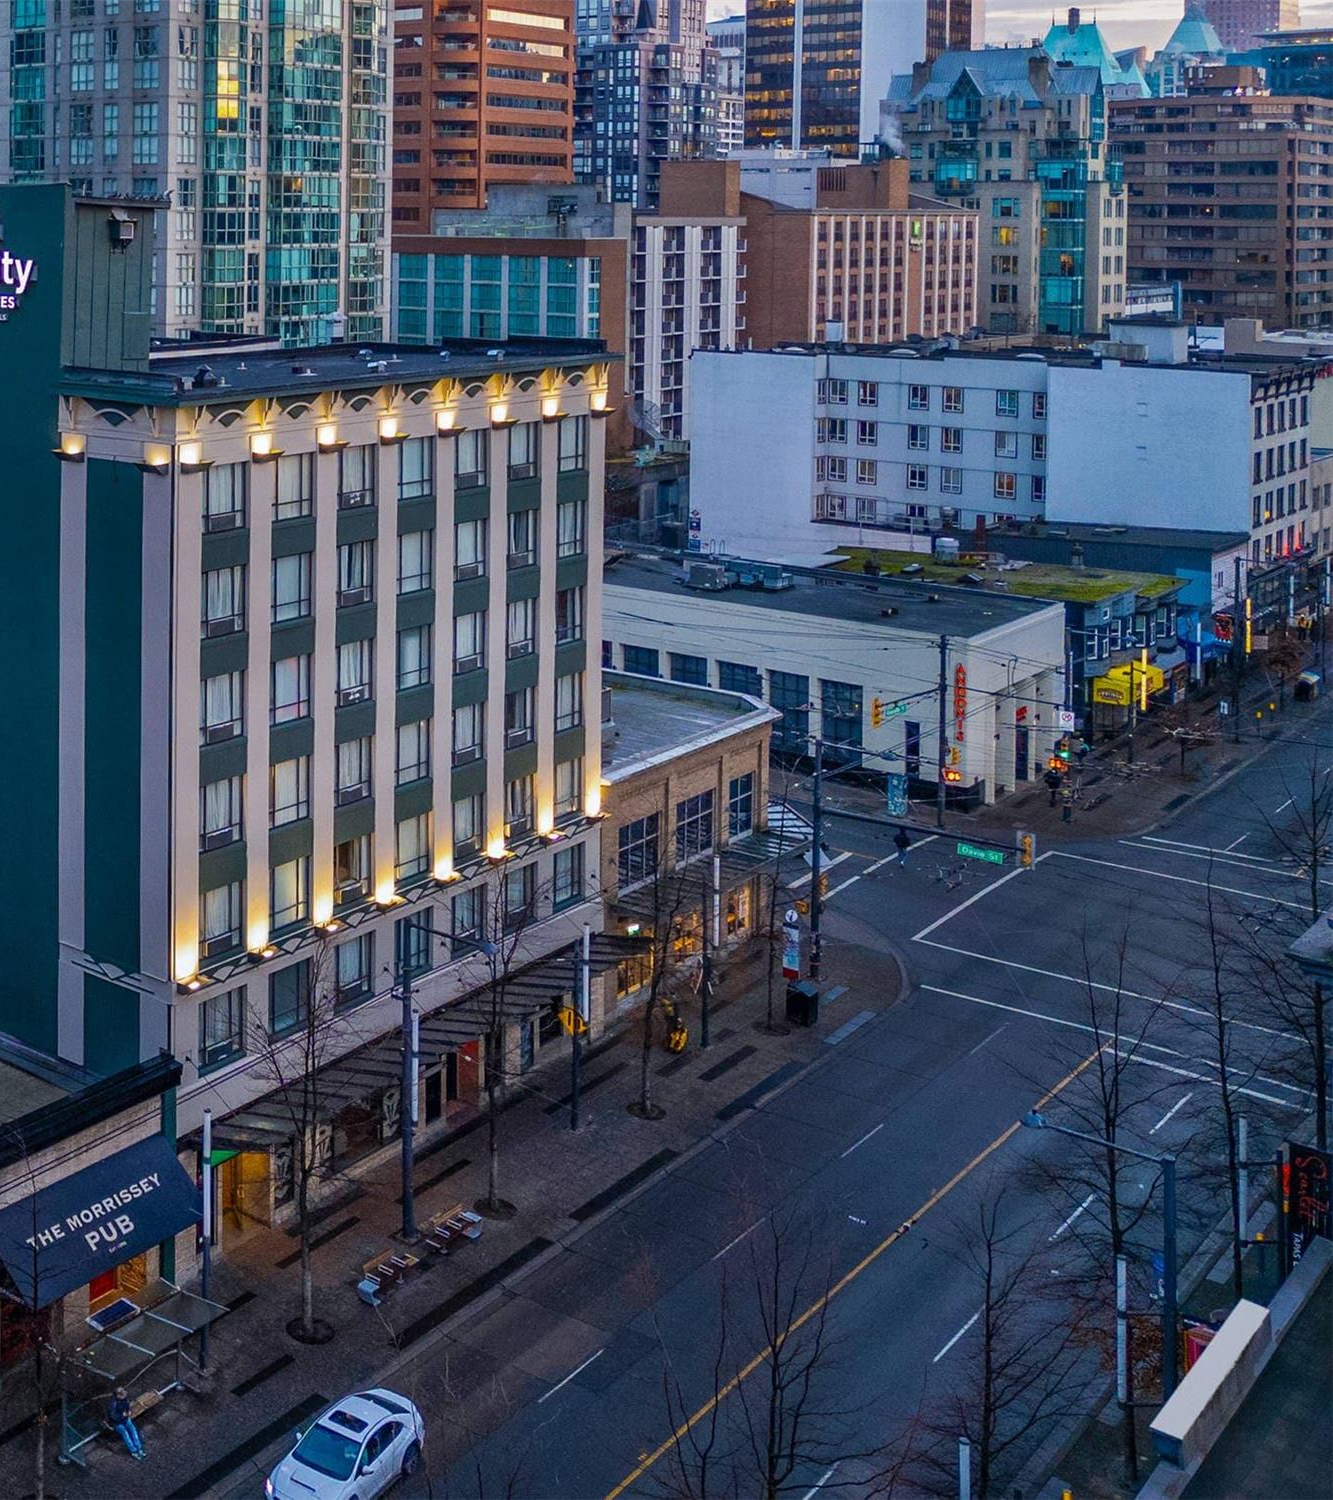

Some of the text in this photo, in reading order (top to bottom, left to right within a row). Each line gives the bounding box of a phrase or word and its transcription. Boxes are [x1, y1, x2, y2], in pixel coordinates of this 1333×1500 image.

[26, 1172, 161, 1251] THE MORRISSEY
[84, 1214, 135, 1252] PUB
